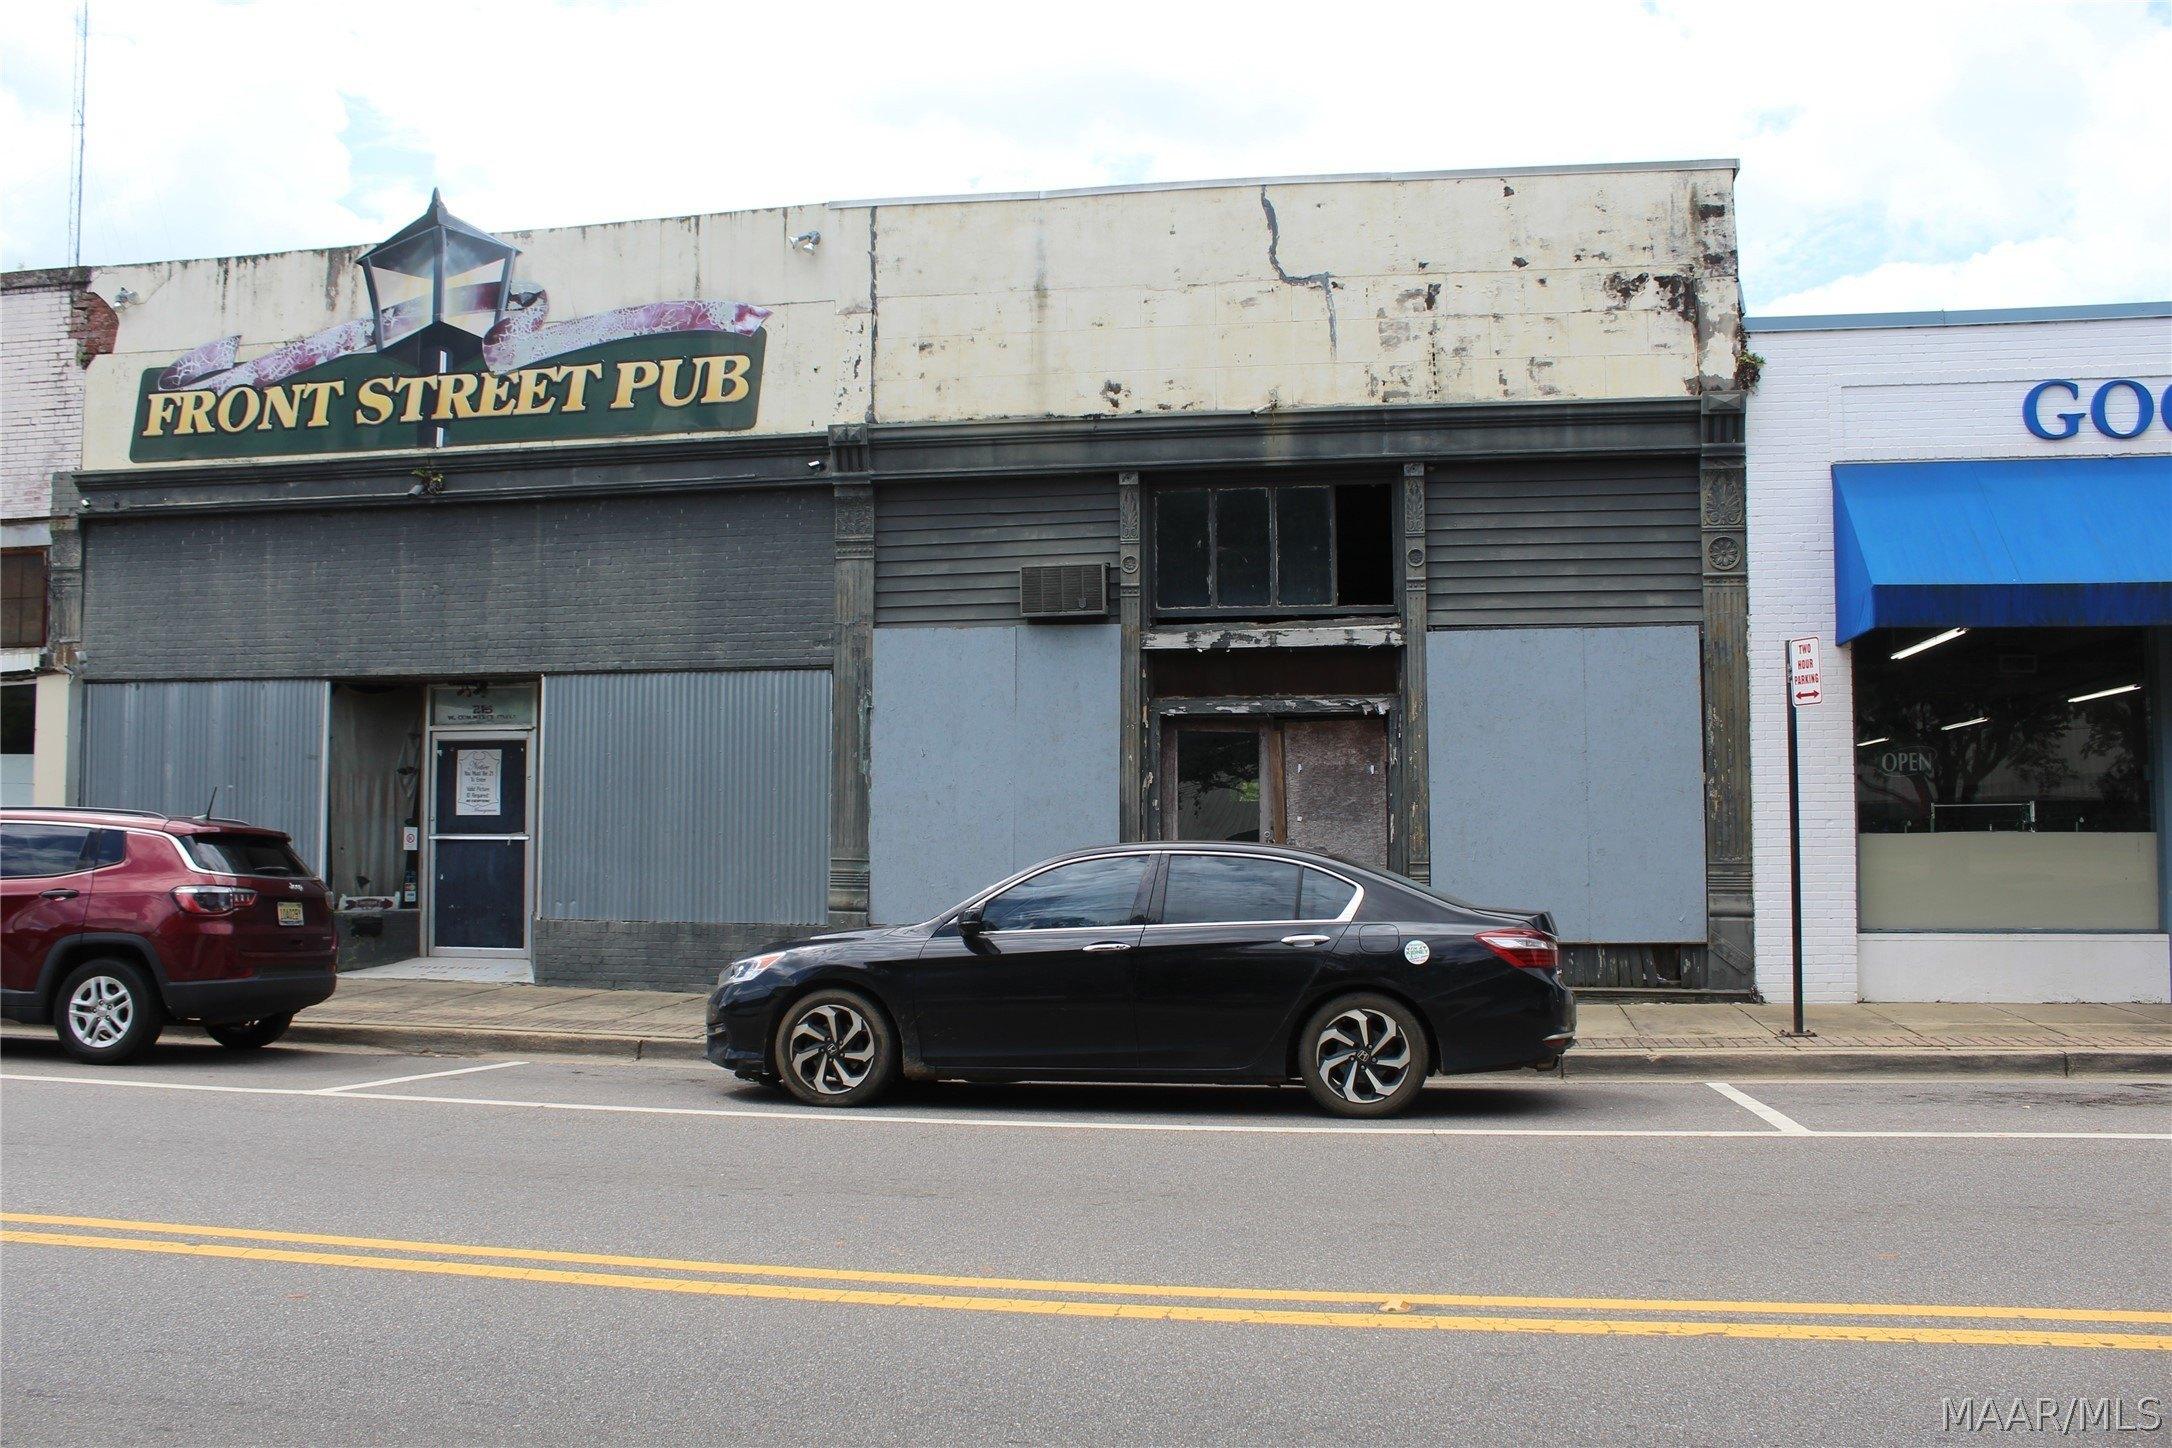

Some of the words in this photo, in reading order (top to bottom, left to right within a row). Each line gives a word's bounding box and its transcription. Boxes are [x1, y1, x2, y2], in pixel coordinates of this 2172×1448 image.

[141, 380, 346, 437] FRONT
[355, 363, 603, 426] STREET
[609, 354, 752, 410] PUB
[2022, 378, 2172, 441] GO
[1798, 643, 1812, 655] TWO
[1797, 658, 1814, 670] HOUR
[1794, 673, 1819, 686] PARKING
[1881, 752, 1932, 772] OPEN
